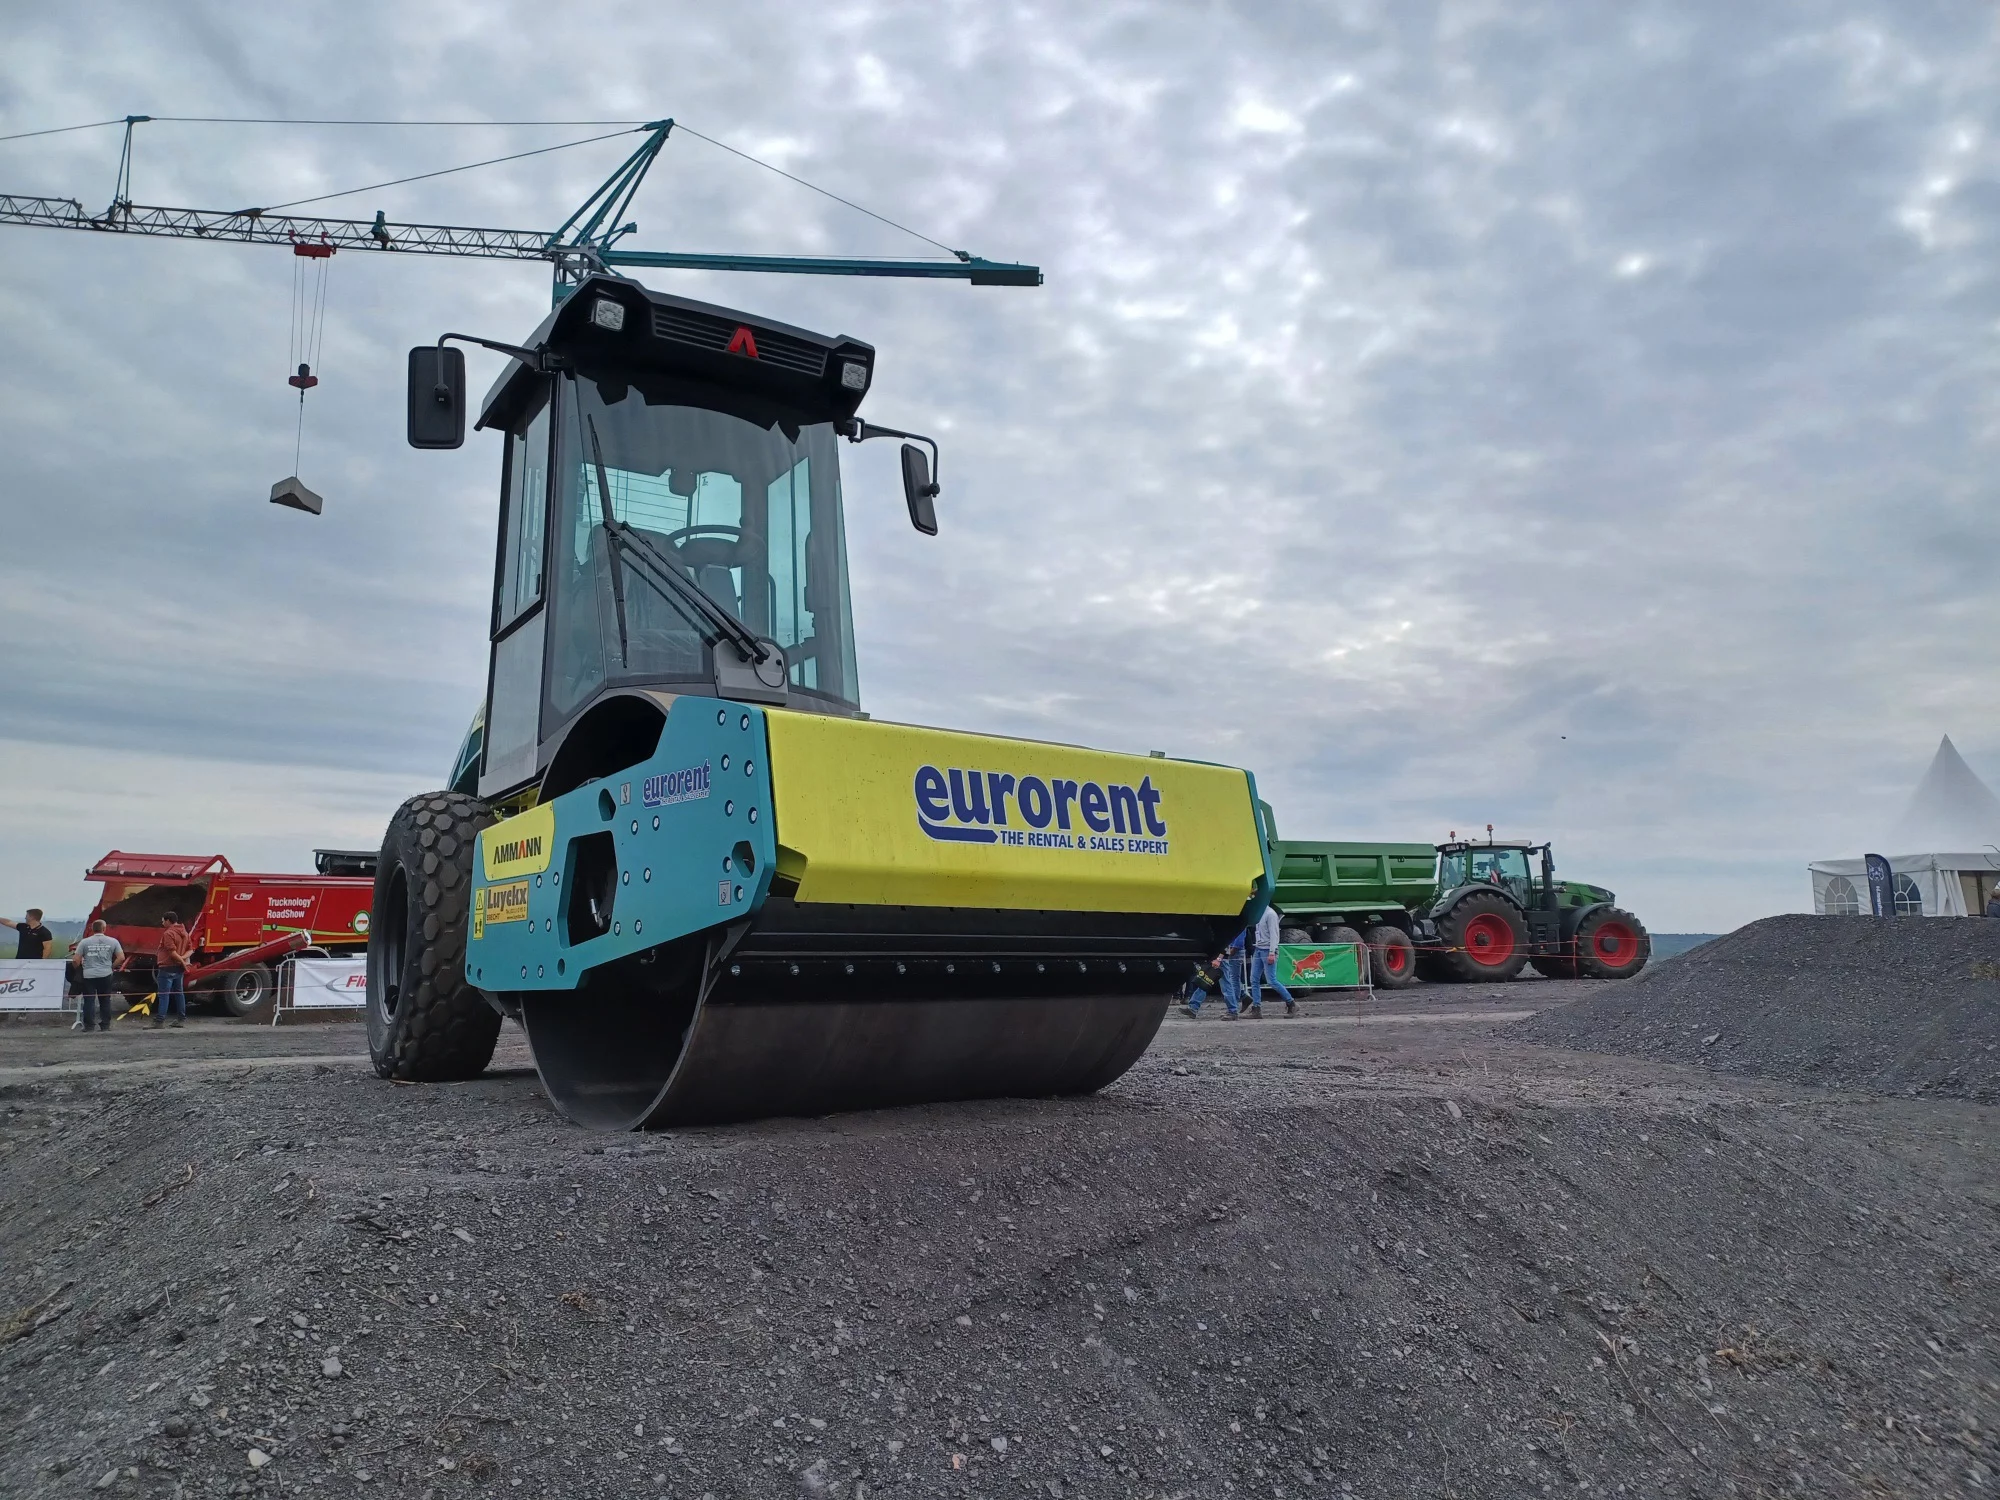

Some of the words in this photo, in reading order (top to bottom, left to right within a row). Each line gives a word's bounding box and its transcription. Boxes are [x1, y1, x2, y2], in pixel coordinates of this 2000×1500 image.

[643, 759, 710, 800] eurorent
[914, 765, 1166, 837] eurorent
[493, 836, 541, 865] AMMANN
[1001, 830, 1024, 845] THE
[1028, 832, 1074, 849] RENTAL
[1077, 836, 1086, 849] &
[1090, 837, 1125, 851] SALES
[1128, 839, 1169, 854] EXPERT
[267, 909, 305, 919] RoadShow
[345, 975, 367, 988] Fli
